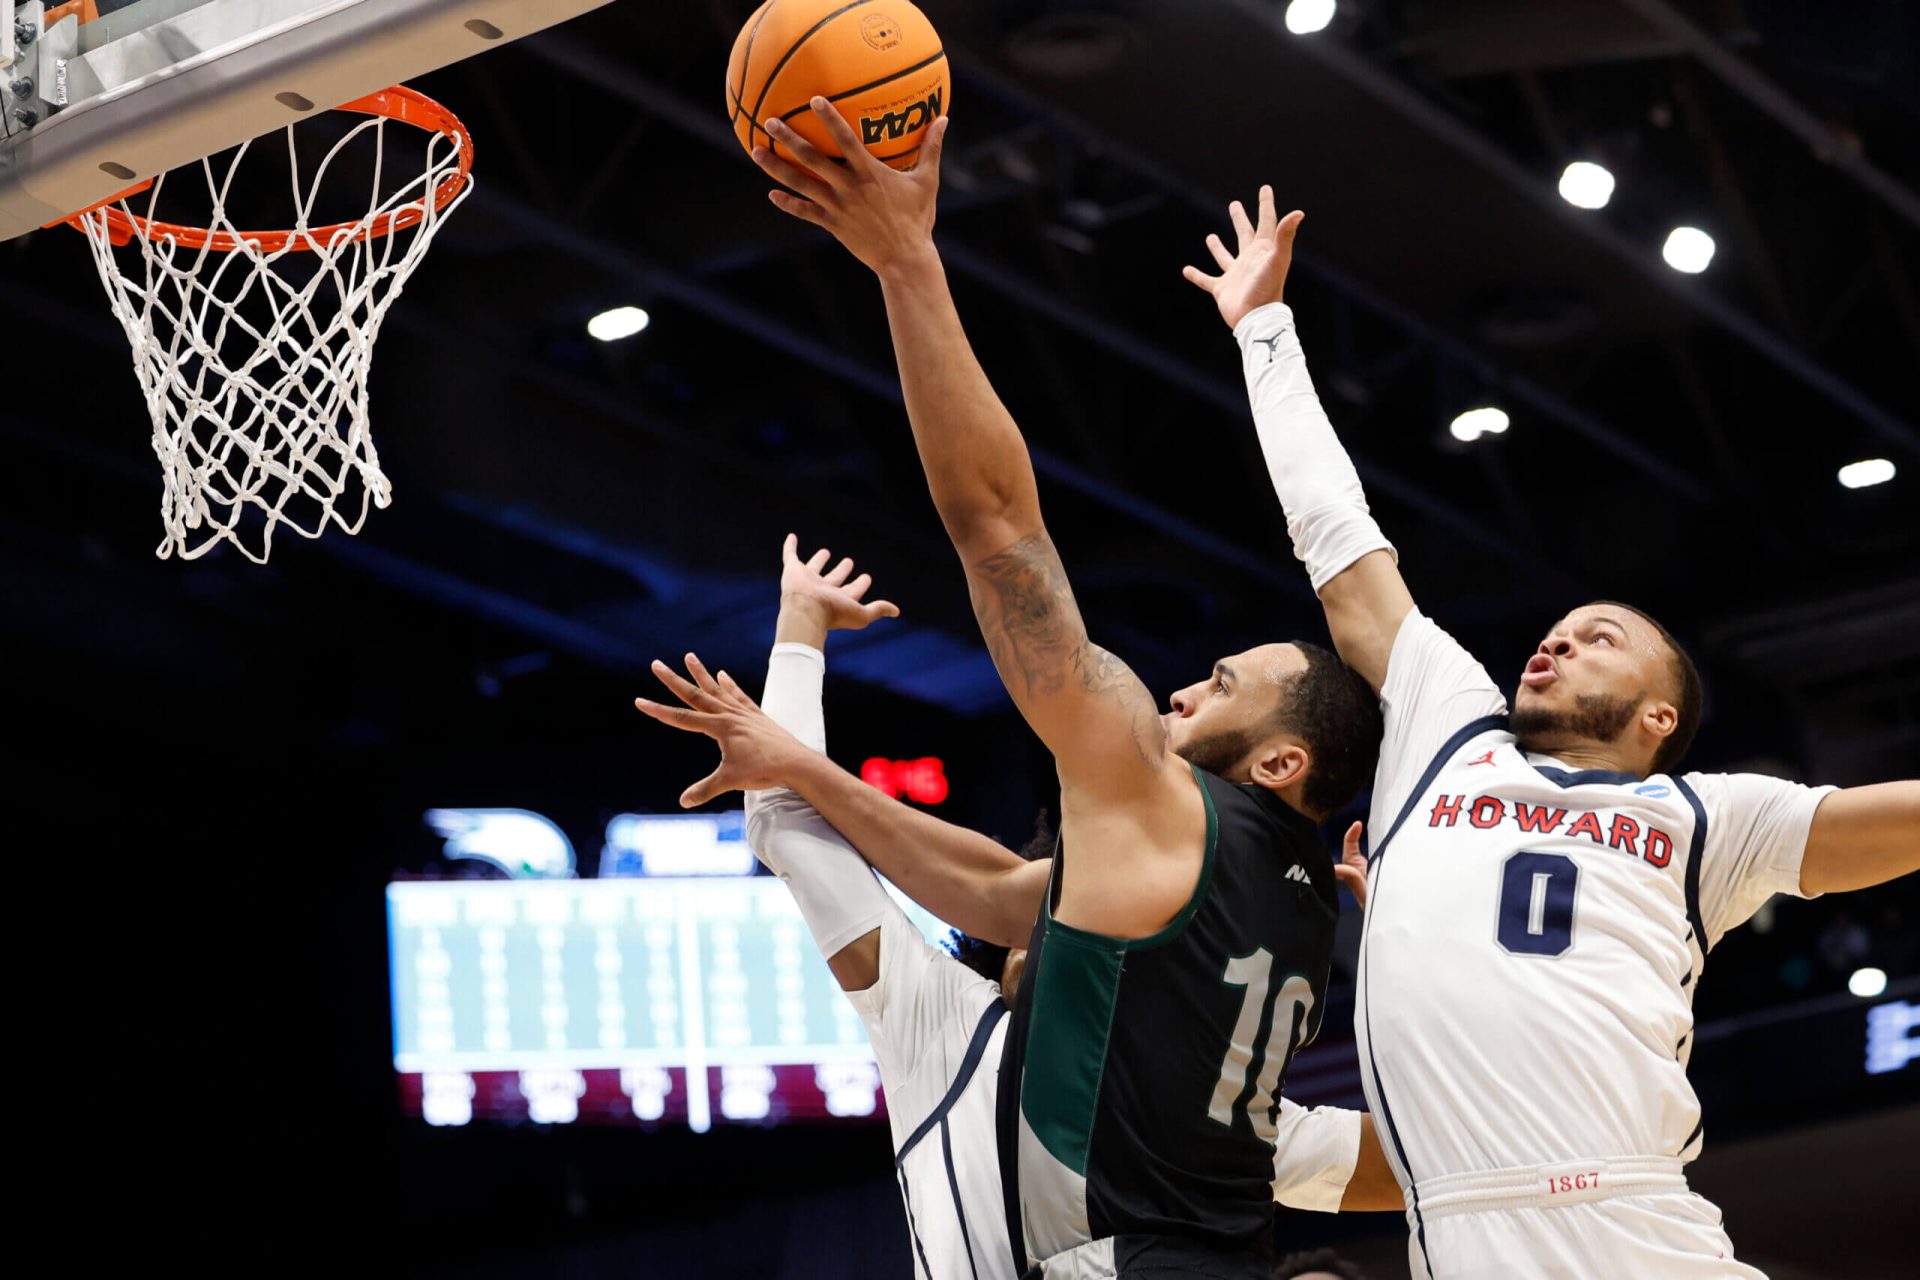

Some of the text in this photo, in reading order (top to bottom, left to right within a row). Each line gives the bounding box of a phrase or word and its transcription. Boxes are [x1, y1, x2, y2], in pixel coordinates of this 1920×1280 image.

[859, 86, 942, 145] NCAA
[1429, 795, 1673, 868] HOWARD
[1493, 848, 1583, 960] 0
[1207, 946, 1315, 1146] 10
[1548, 1172, 1599, 1194] 1867
